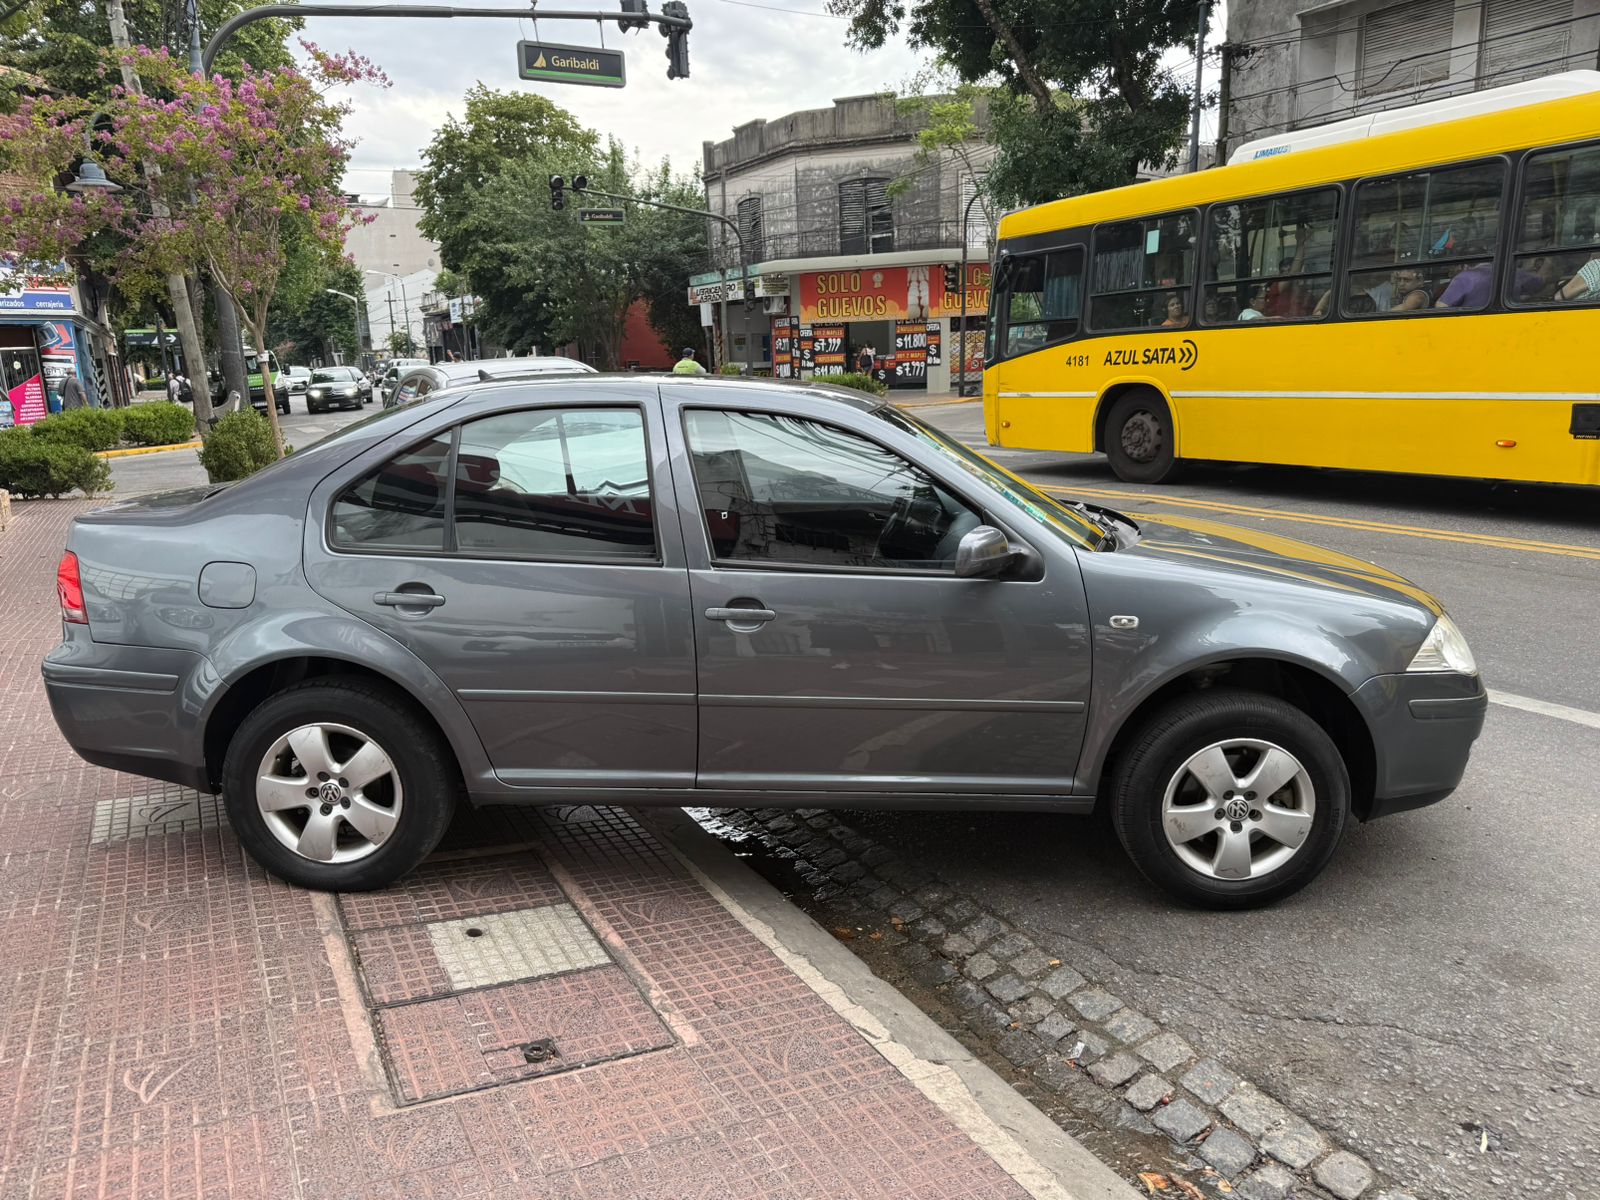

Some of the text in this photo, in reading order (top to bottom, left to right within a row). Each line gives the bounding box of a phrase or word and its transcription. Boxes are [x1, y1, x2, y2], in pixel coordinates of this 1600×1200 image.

[551, 55, 600, 70] Garibaldi
[817, 273, 861, 294] SOLO
[817, 296, 886, 318] GUEVOS
[943, 289, 990, 309] GUEVO
[1065, 347, 1177, 367] 4181 AZUL SATA
